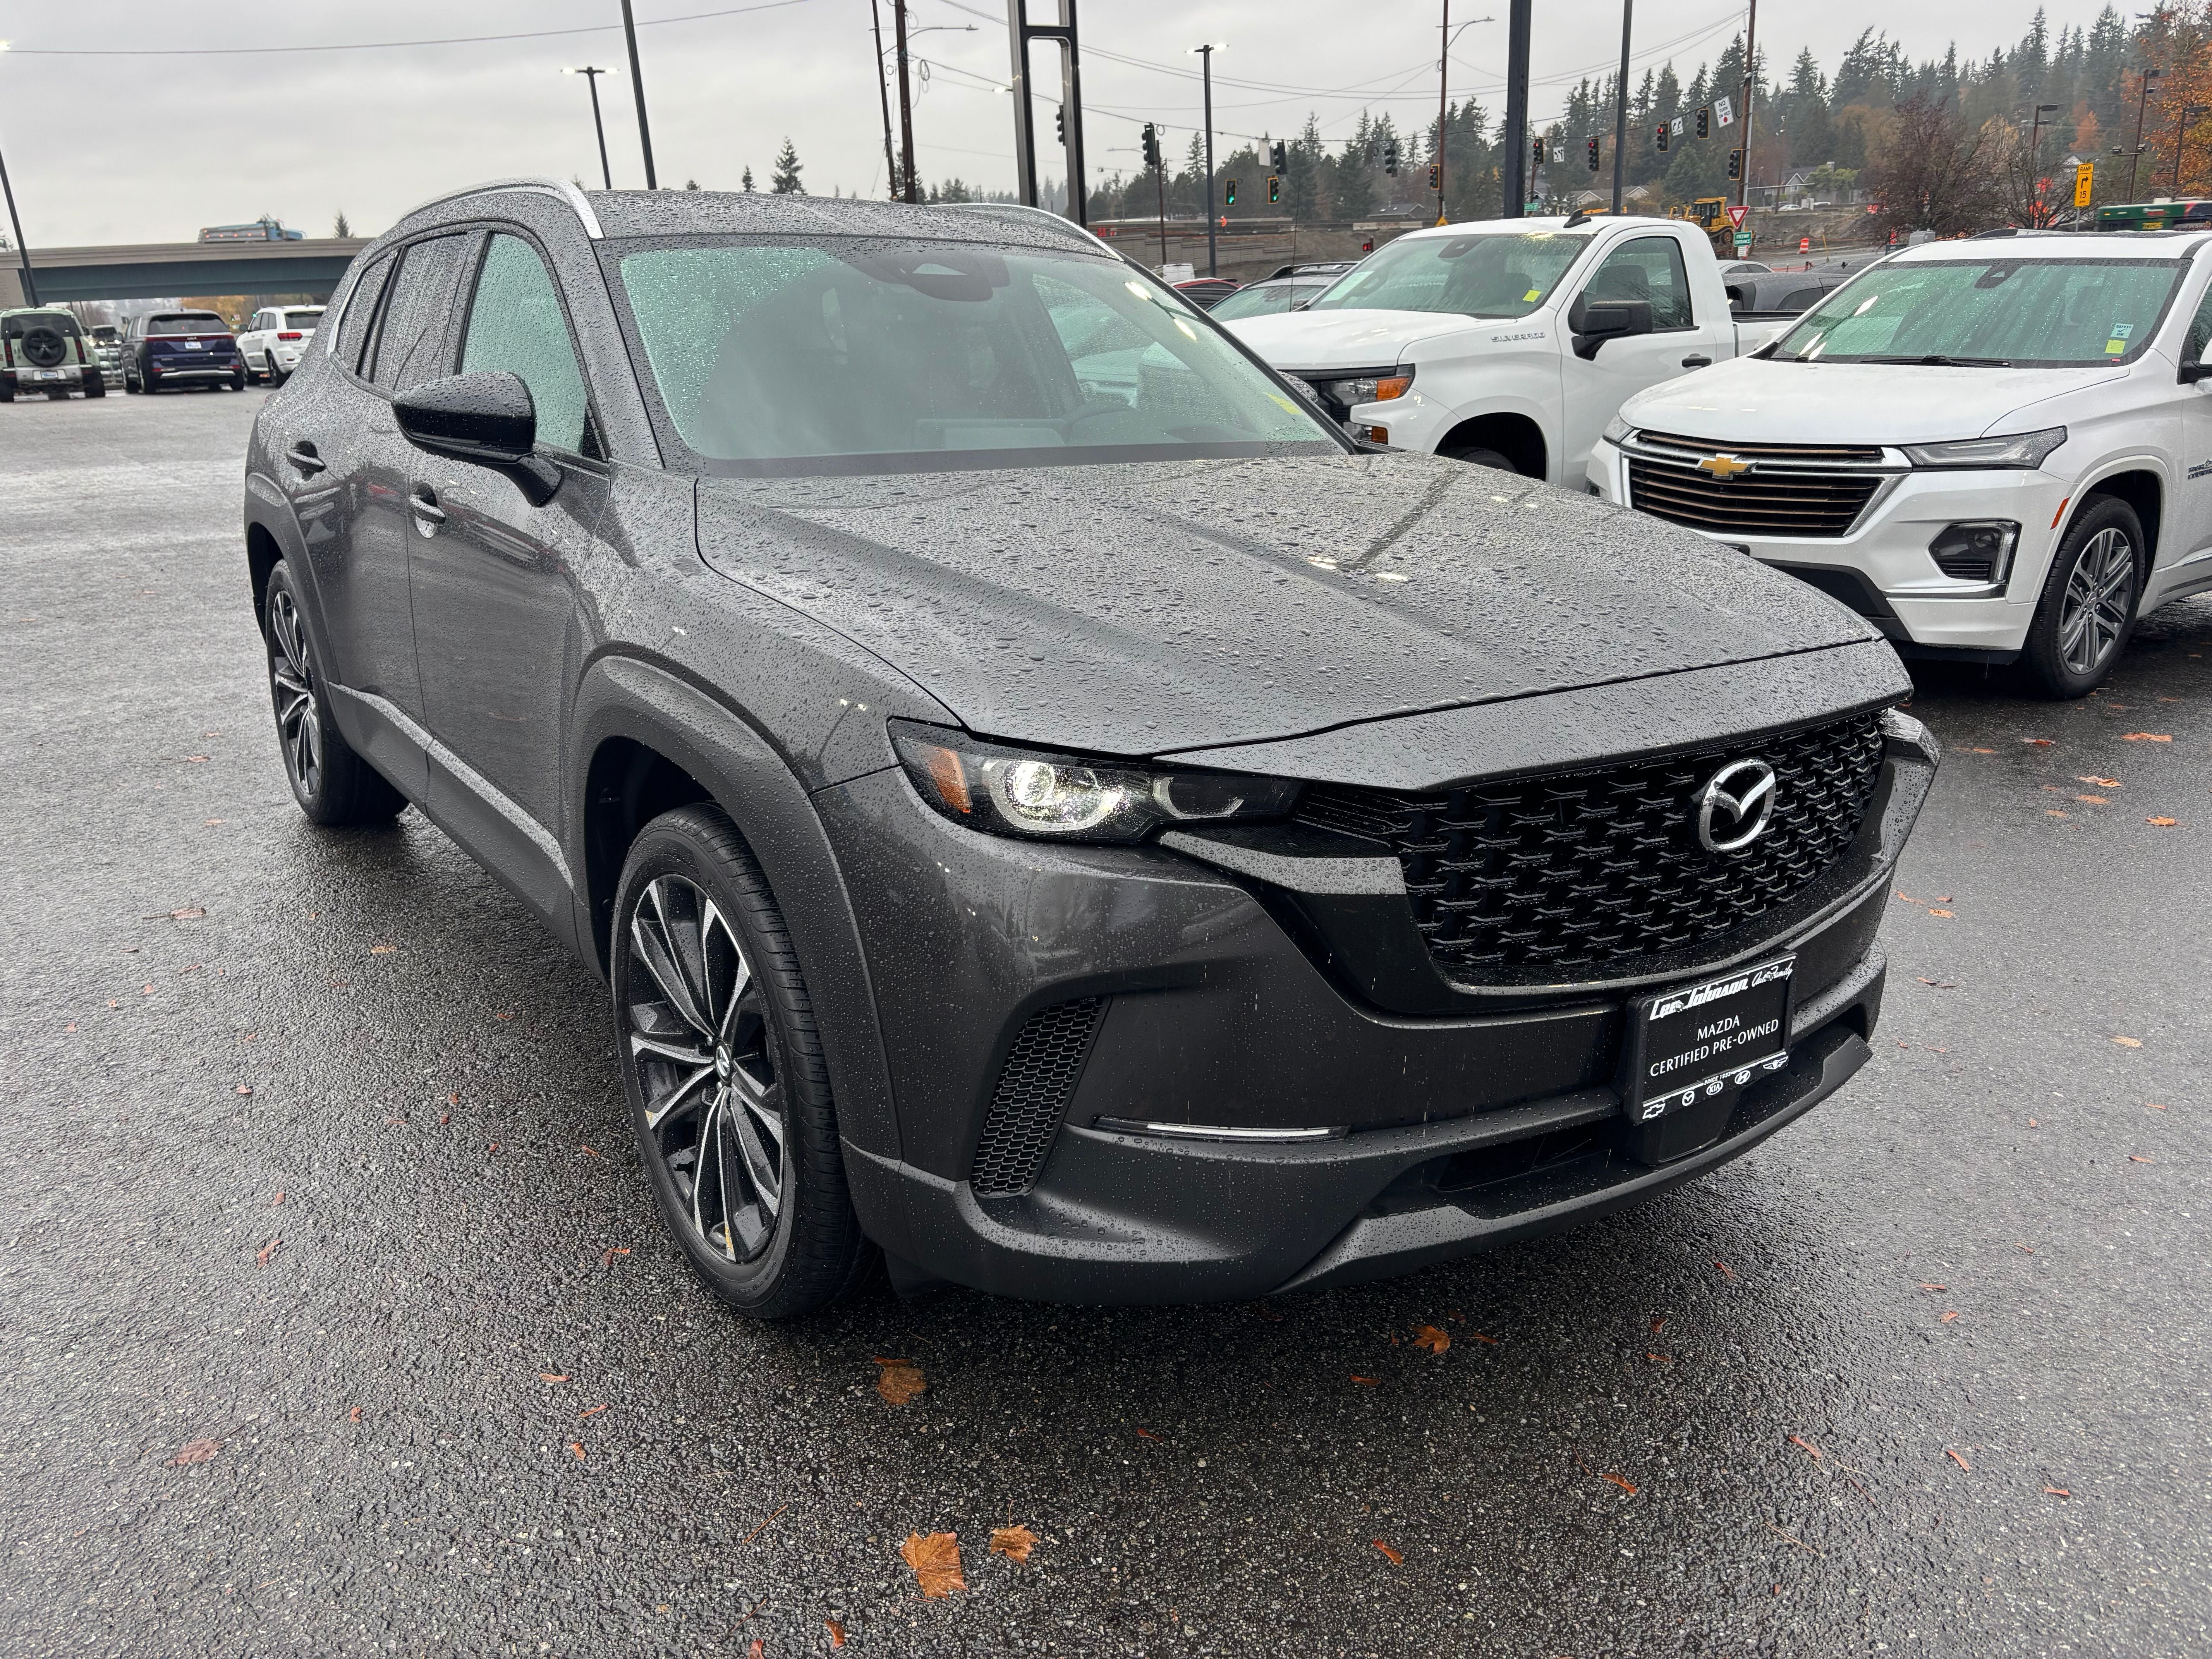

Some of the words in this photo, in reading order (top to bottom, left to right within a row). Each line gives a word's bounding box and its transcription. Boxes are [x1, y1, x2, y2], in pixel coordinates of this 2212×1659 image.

[2080, 191, 2087, 199] 15
[1491, 332, 1545, 342] SILVERADO
[1683, 978, 1748, 1009] Johnson
[1771, 961, 1793, 981] Family
[1697, 1015, 1740, 1041] MAZDA
[1650, 1046, 1709, 1077] CERTIFIED
[1713, 1019, 1779, 1054] PRE-OWNED
[1704, 1076, 1719, 1085] SINCE
[1709, 1083, 1721, 1094] KIA
